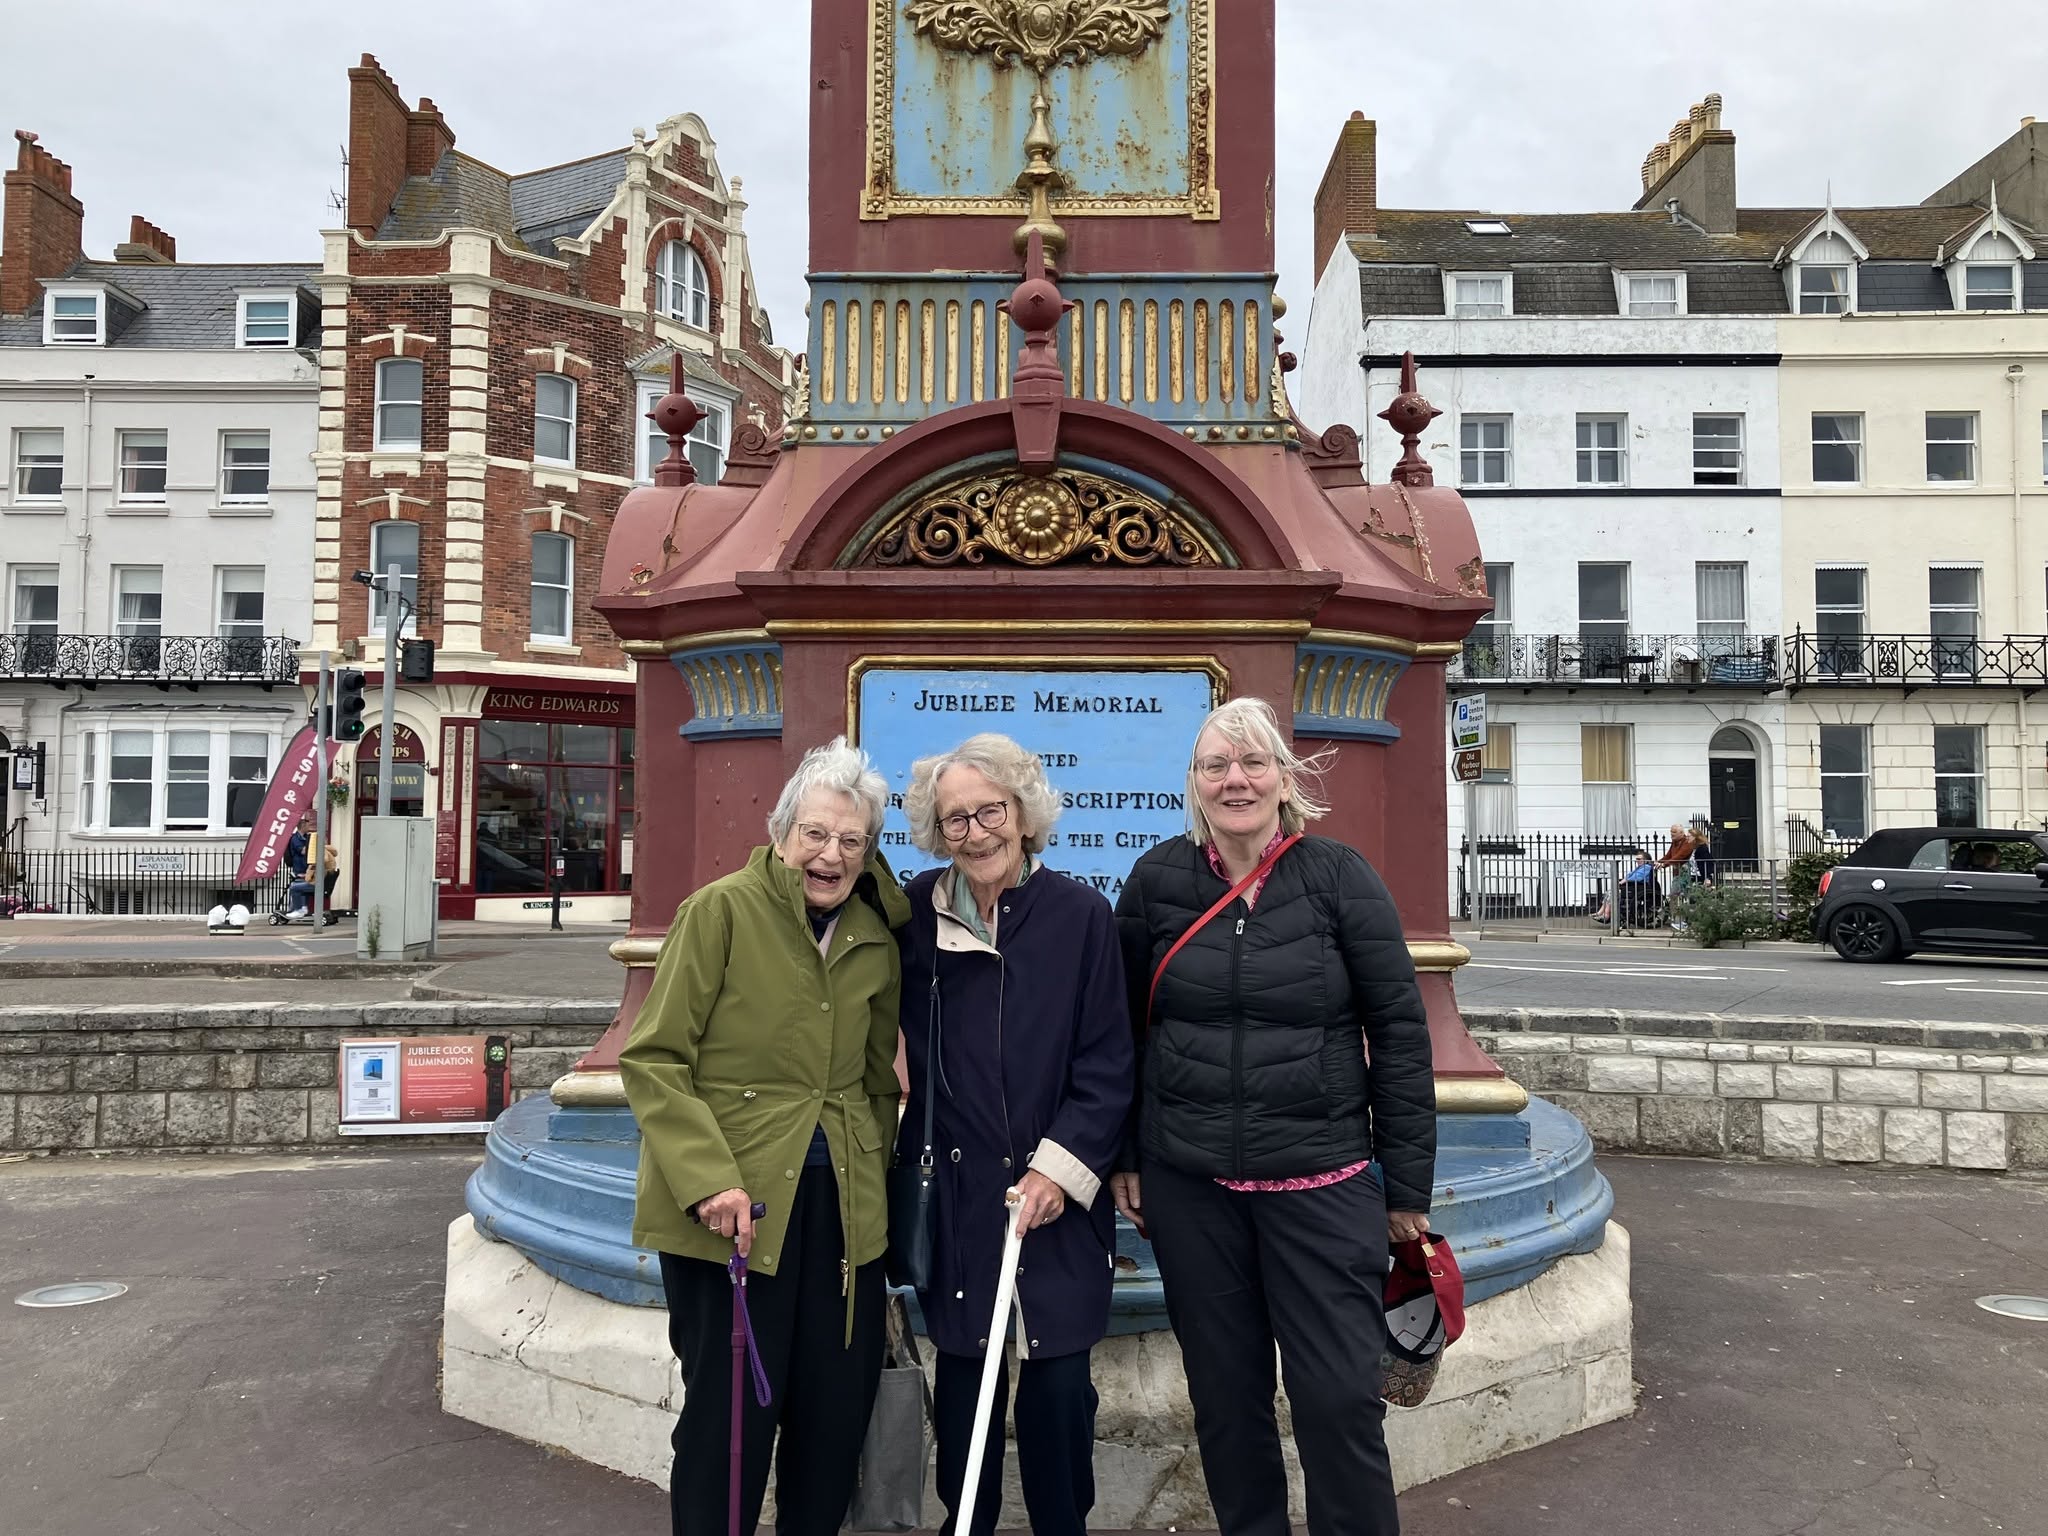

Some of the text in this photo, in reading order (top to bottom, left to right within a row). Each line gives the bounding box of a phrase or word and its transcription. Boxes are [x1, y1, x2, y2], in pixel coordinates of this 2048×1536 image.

[489, 693, 620, 714] KING EDWARDS
[914, 690, 1163, 713] JUBILEE MEMORIAL
[374, 746, 410, 758] CIPS
[1466, 752, 1475, 760] Old
[1461, 760, 1480, 770] Harbour
[1464, 769, 1478, 777] South
[365, 775, 419, 785] TAAWAY
[283, 789, 297, 804] &
[255, 807, 290, 874] CHIPS
[1068, 833, 1104, 847] THE
[407, 1045, 474, 1056] JUBILEE CLOCK
[407, 1056, 474, 1067] ILLUMINATION
